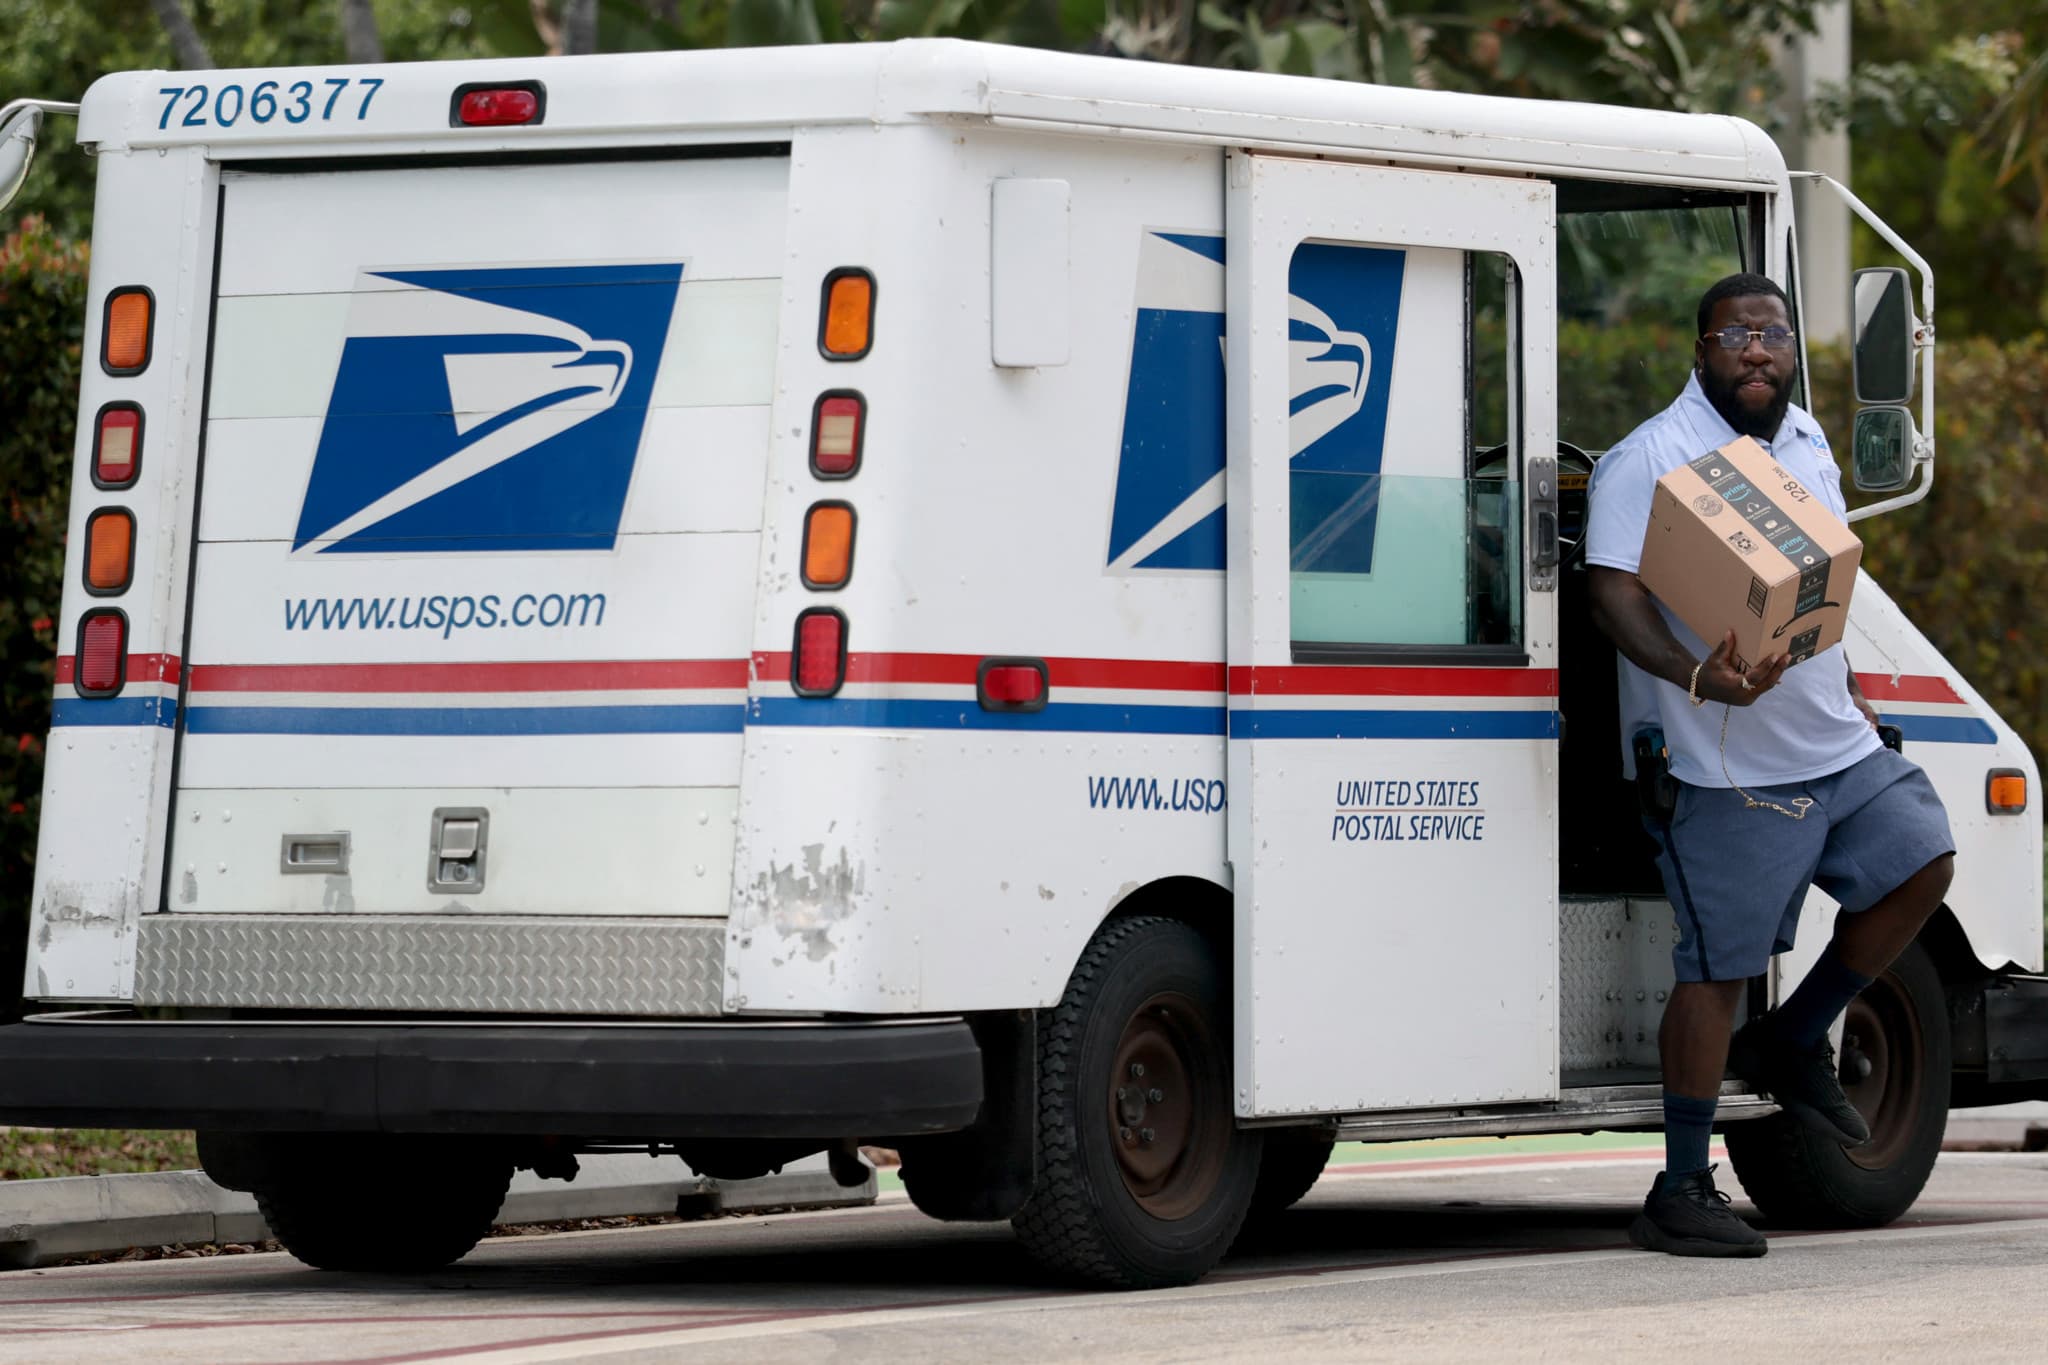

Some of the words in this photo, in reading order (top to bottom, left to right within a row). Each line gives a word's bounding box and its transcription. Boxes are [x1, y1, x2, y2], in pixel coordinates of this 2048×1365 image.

[158, 78, 385, 130] 7206377
[1722, 483, 1748, 500] prime
[1783, 480, 1811, 504] 128
[1778, 535, 1805, 553] prime
[285, 592, 606, 640] www.usps.com
[1088, 775, 1227, 815] www.usp
[1337, 780, 1411, 807] UNITED
[1415, 780, 1480, 807] STATES
[1332, 814, 1404, 841] POSTAL
[1408, 814, 1485, 841] SERVICE
